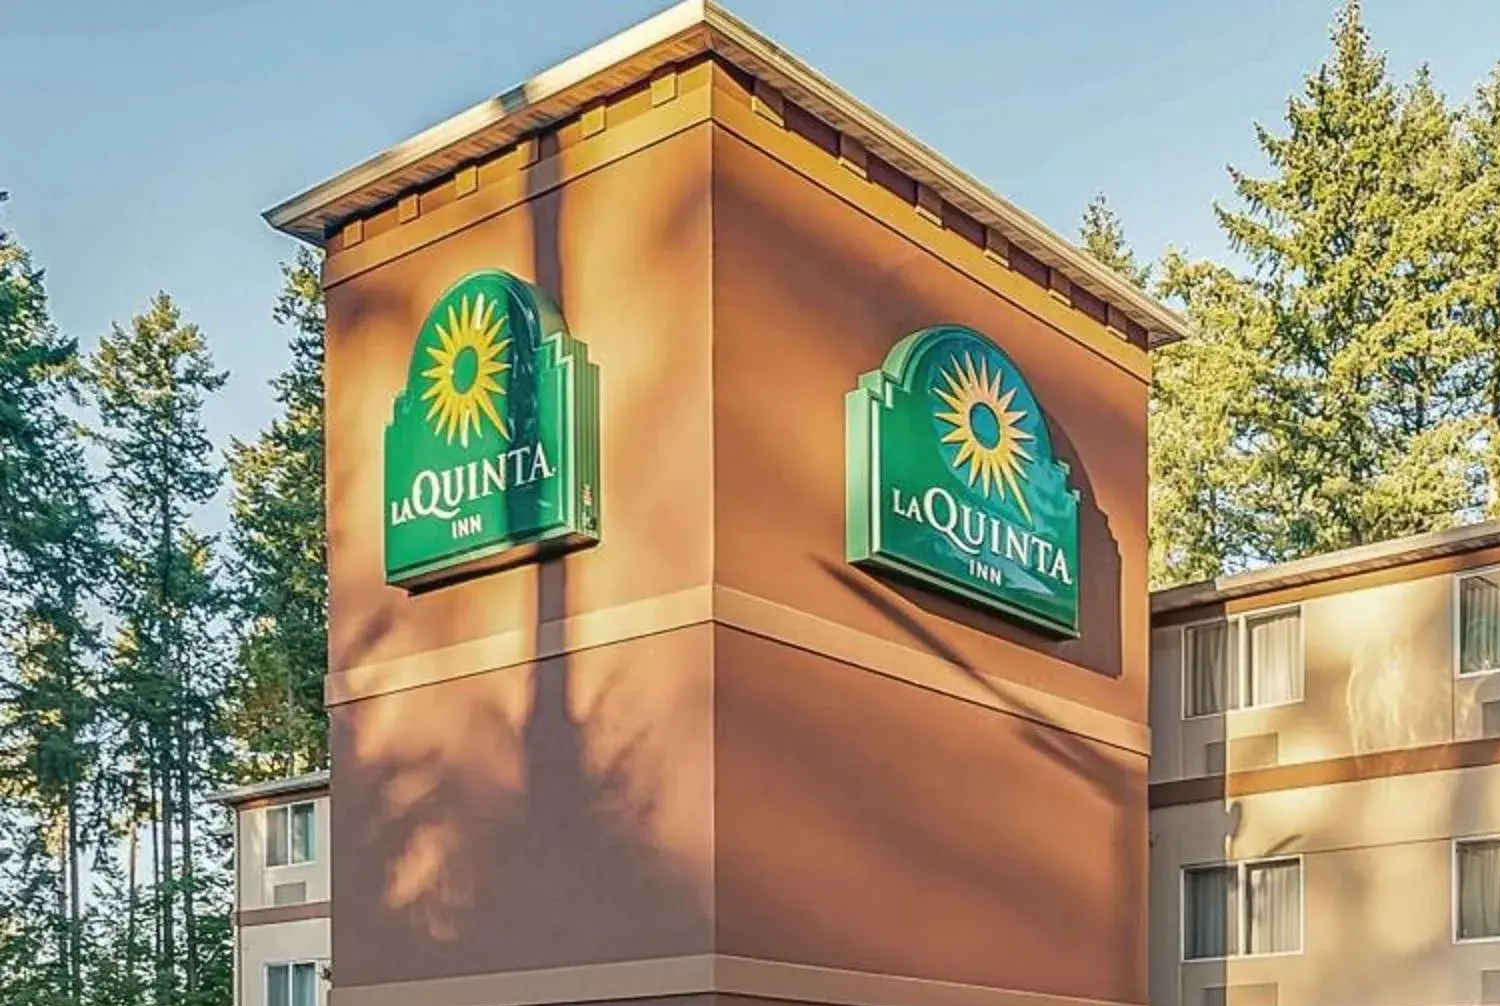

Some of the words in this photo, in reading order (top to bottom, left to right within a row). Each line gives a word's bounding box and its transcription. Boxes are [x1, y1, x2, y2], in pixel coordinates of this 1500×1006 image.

[391, 498, 415, 525] LA
[412, 442, 553, 519] QUINTA
[452, 514, 482, 539] INN
[892, 488, 924, 523] LA
[923, 487, 1072, 585] QUINTA
[969, 559, 1001, 585] INN
